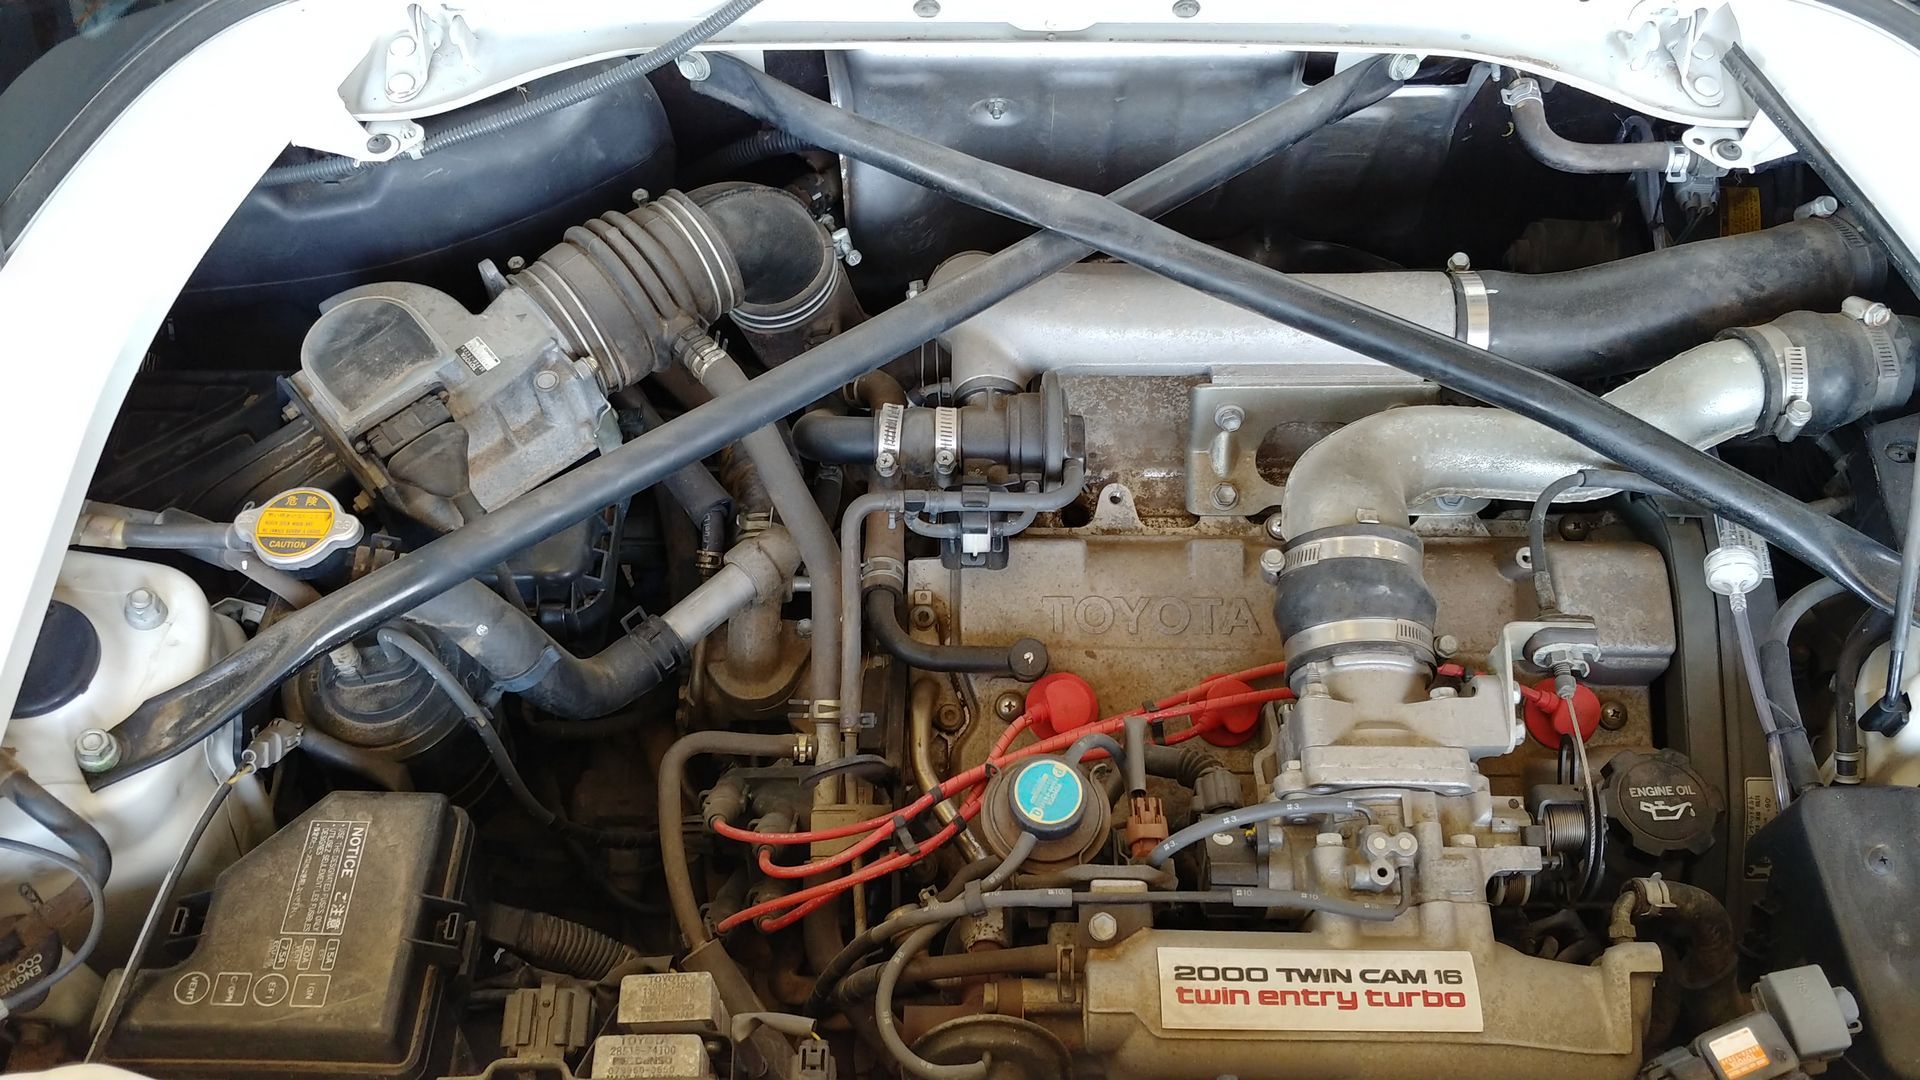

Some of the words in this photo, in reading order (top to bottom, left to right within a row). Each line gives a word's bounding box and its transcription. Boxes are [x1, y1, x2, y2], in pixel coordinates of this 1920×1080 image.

[285, 495, 319, 507] 危険
[269, 540, 307, 549] CAUTION
[1041, 595, 1263, 636] TOYOTA
[1628, 786, 1675, 798] ENGINE
[1675, 785, 1697, 796] OIL
[340, 827, 364, 878] NOTICE
[322, 855, 338, 891] DESIGNATED
[325, 891, 349, 930] ご注意
[302, 945, 312, 963] 20A
[325, 947, 336, 964] 15A
[649, 975, 688, 984] TOYOTA
[1173, 966, 1268, 982] 2000
[1275, 968, 1353, 984] TWIN
[1359, 968, 1427, 984] CAM
[1434, 970, 1463, 984] 16
[185, 976, 200, 1001] VENT
[265, 981, 277, 999] EFI
[305, 982, 316, 1000] IGN
[1175, 986, 1250, 1005] twin
[1258, 988, 1358, 1010] entry
[1365, 989, 1466, 1008] turbo
